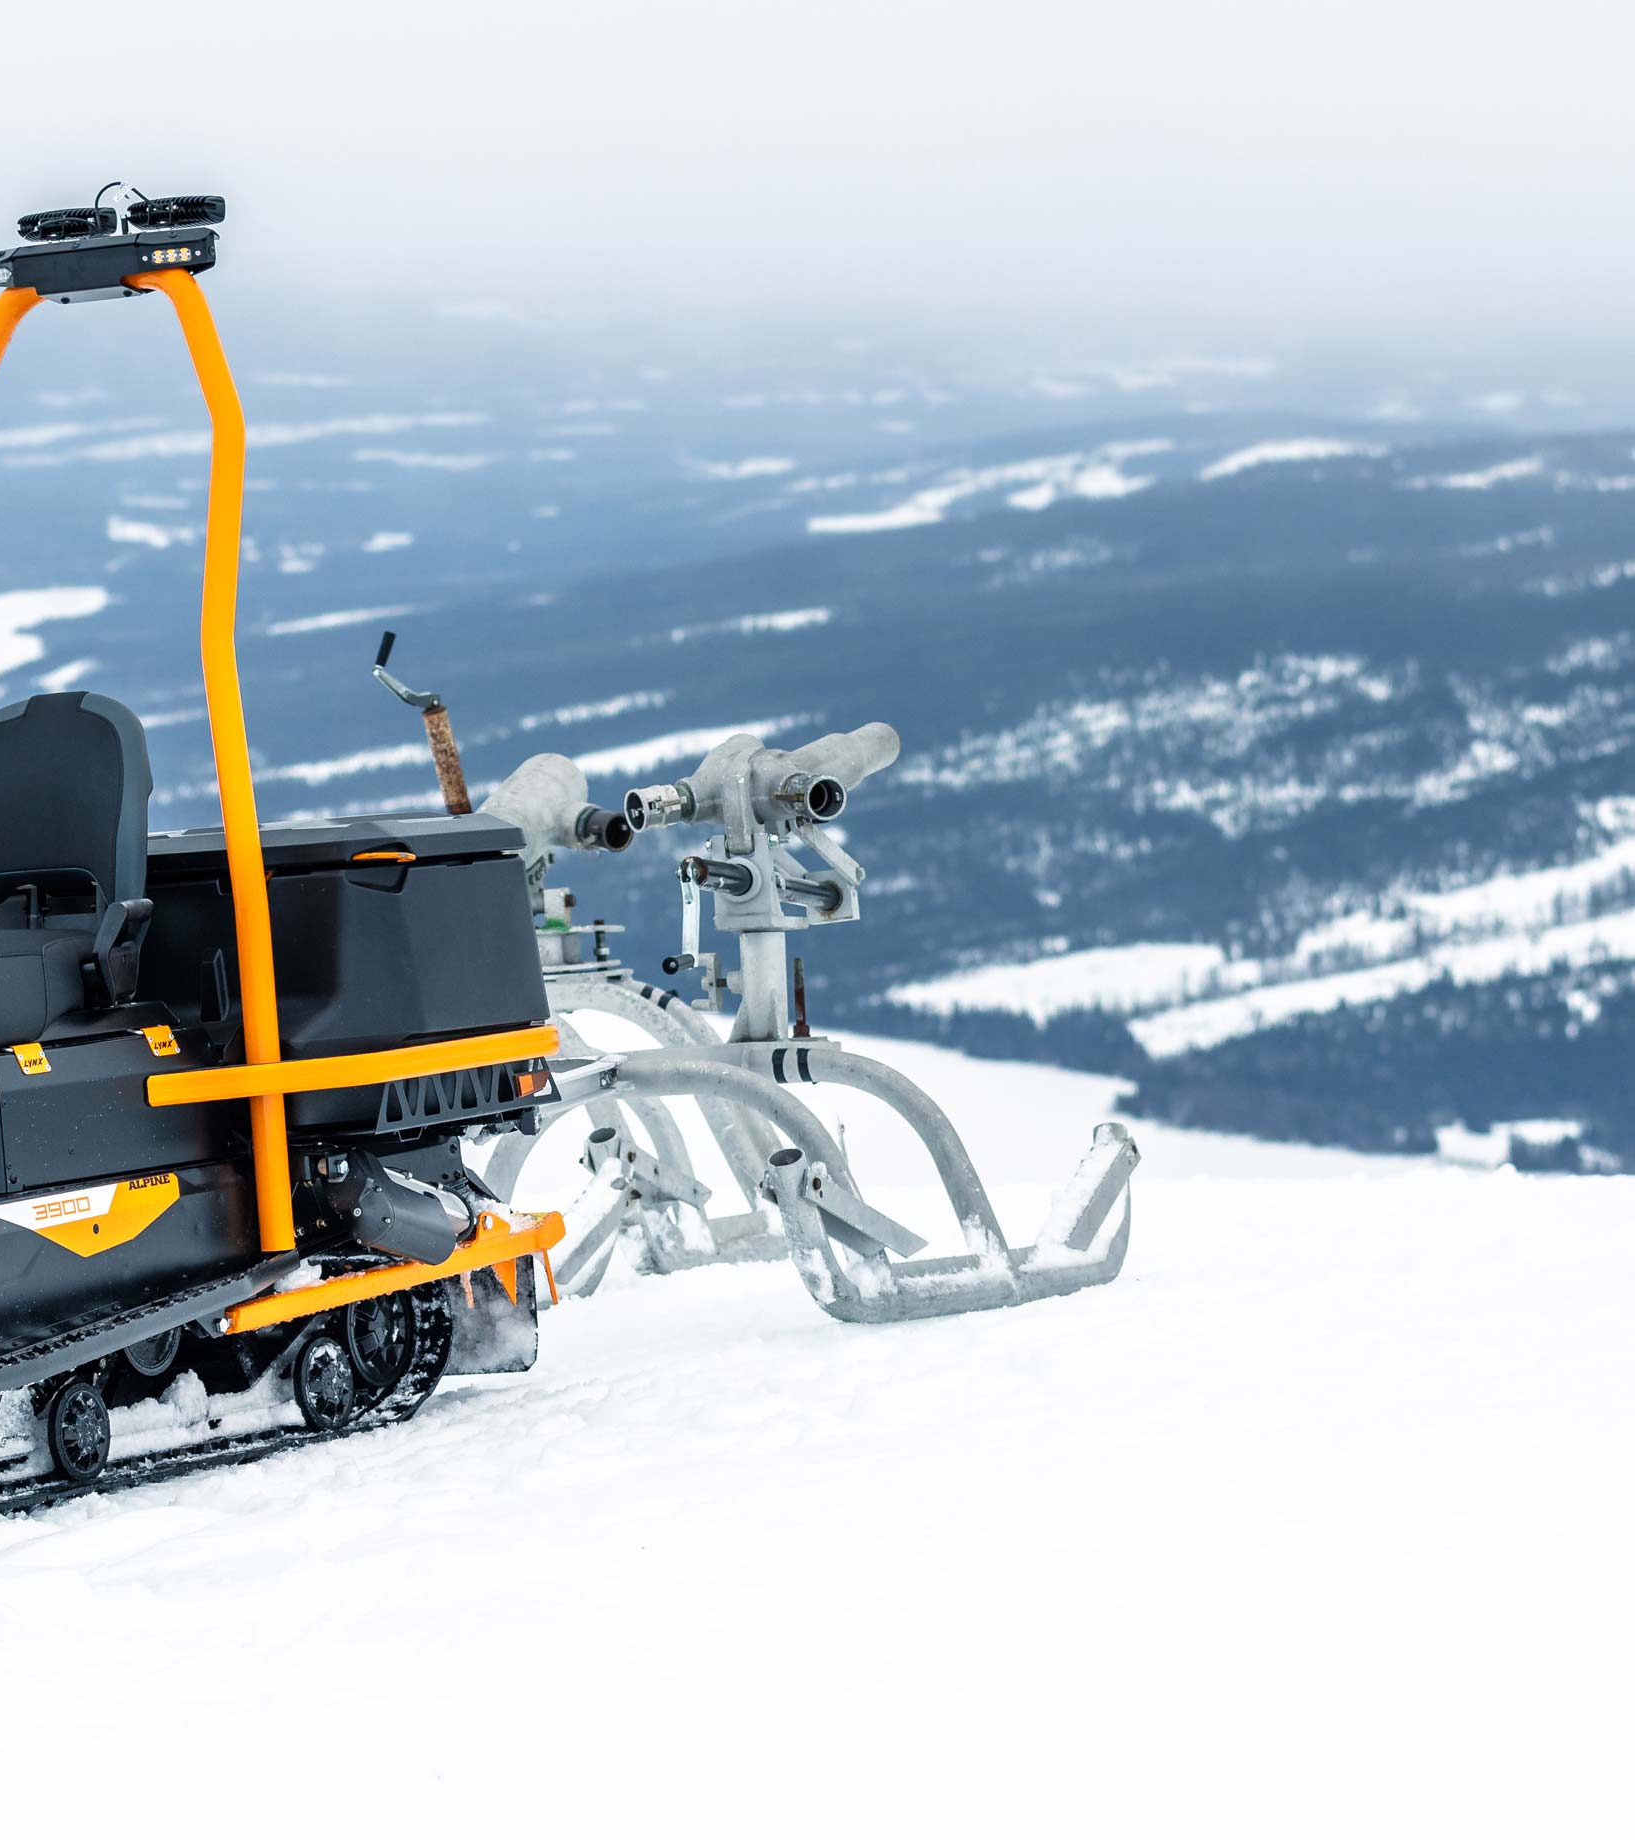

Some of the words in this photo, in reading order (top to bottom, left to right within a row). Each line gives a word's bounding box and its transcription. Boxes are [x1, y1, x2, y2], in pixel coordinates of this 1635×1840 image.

[153, 1039, 173, 1050] LYNX
[24, 1057, 44, 1068] LYNX
[128, 1174, 171, 1191] ALPINE
[32, 1196, 91, 1221] 3900
